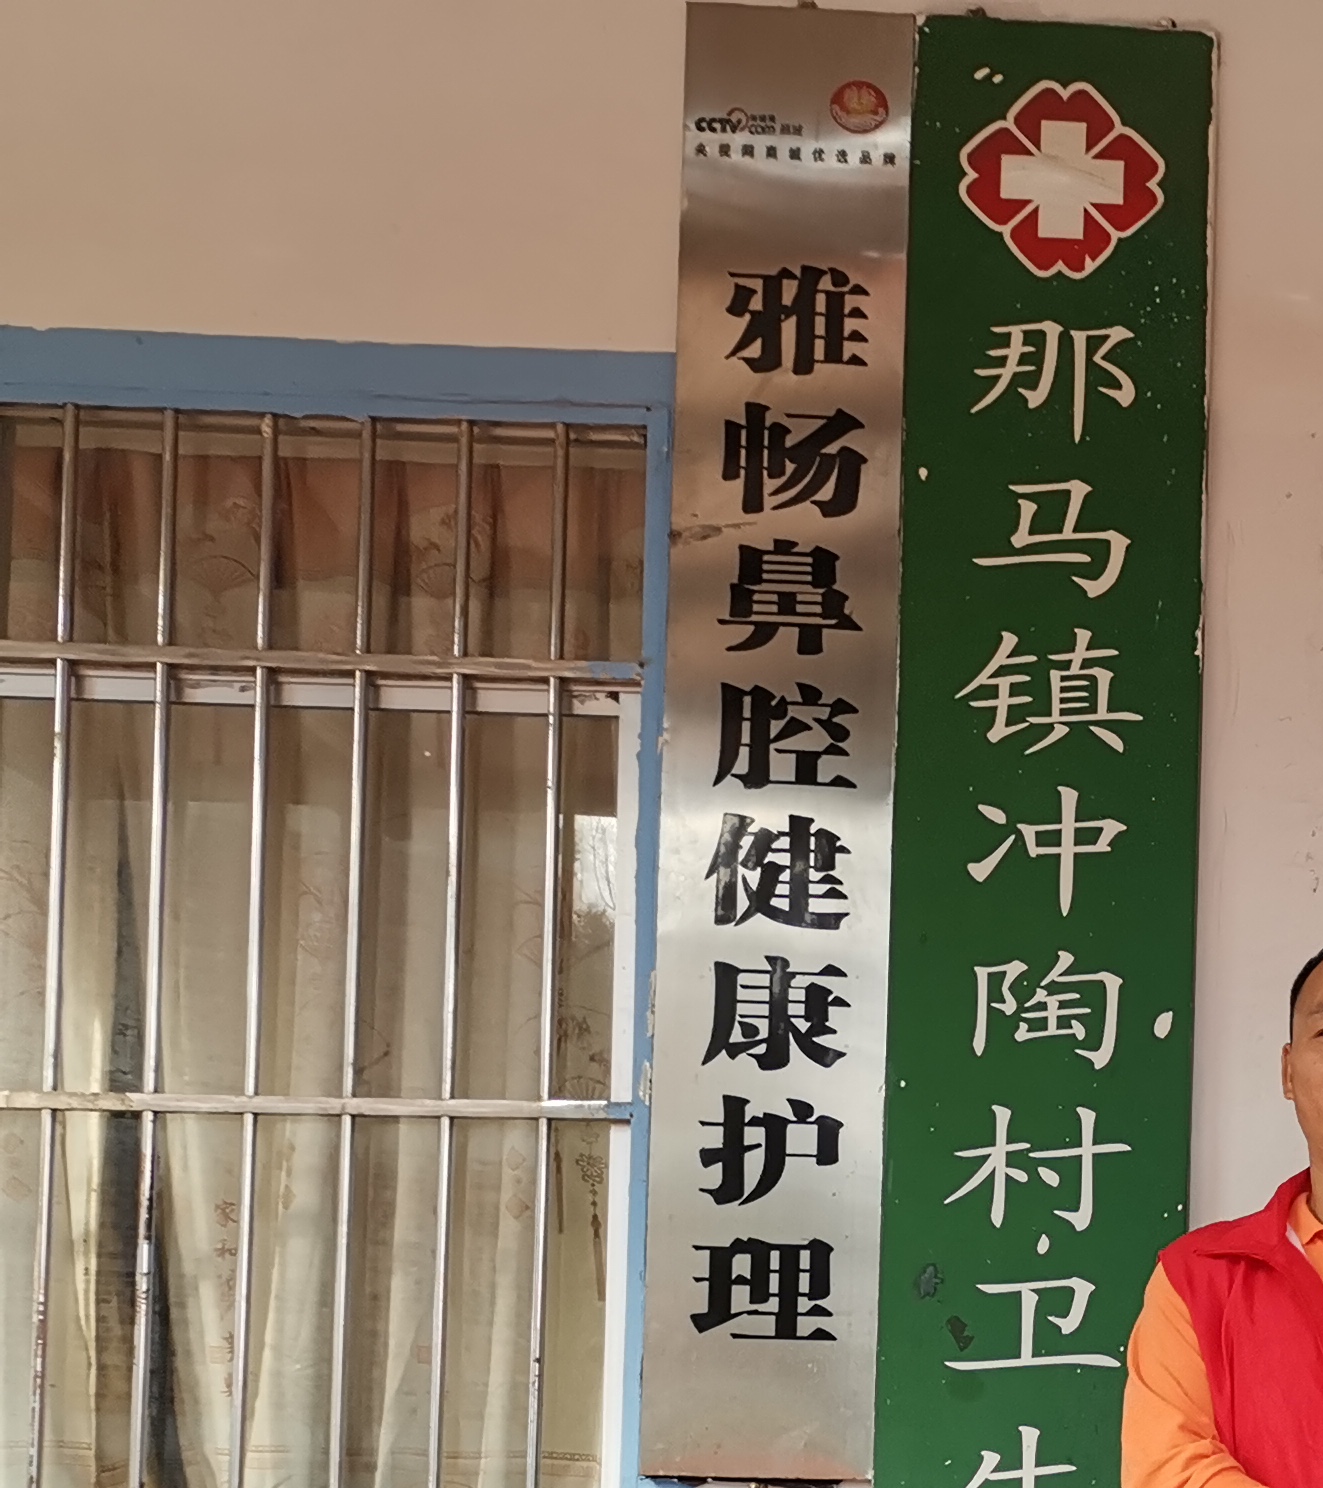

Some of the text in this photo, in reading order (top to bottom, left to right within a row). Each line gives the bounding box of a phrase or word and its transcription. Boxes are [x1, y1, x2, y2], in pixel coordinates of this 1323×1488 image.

[695, 116, 743, 135] CCTV
[689, 264, 871, 1342] 雅畅鼻腔健康护理
